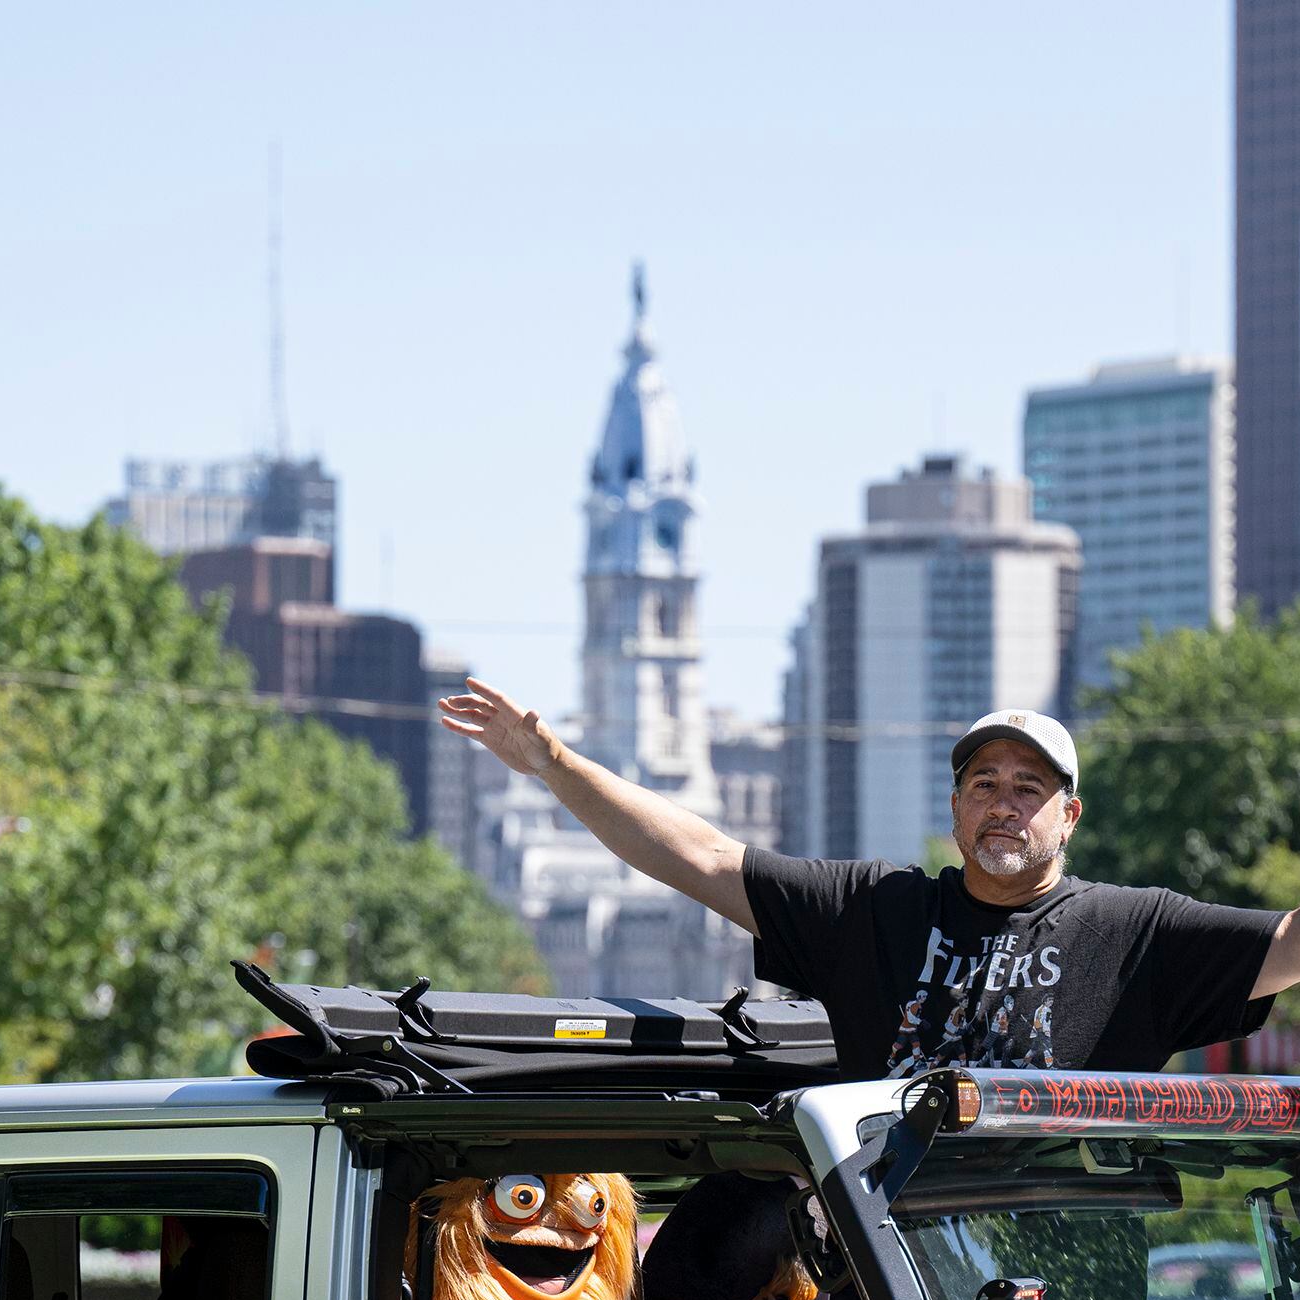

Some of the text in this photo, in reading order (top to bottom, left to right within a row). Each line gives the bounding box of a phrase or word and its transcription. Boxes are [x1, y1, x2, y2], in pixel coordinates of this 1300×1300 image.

[918, 926, 1061, 991] FLYERS
[981, 934, 1019, 953] THE
[1129, 1077, 1235, 1124] CHILD
